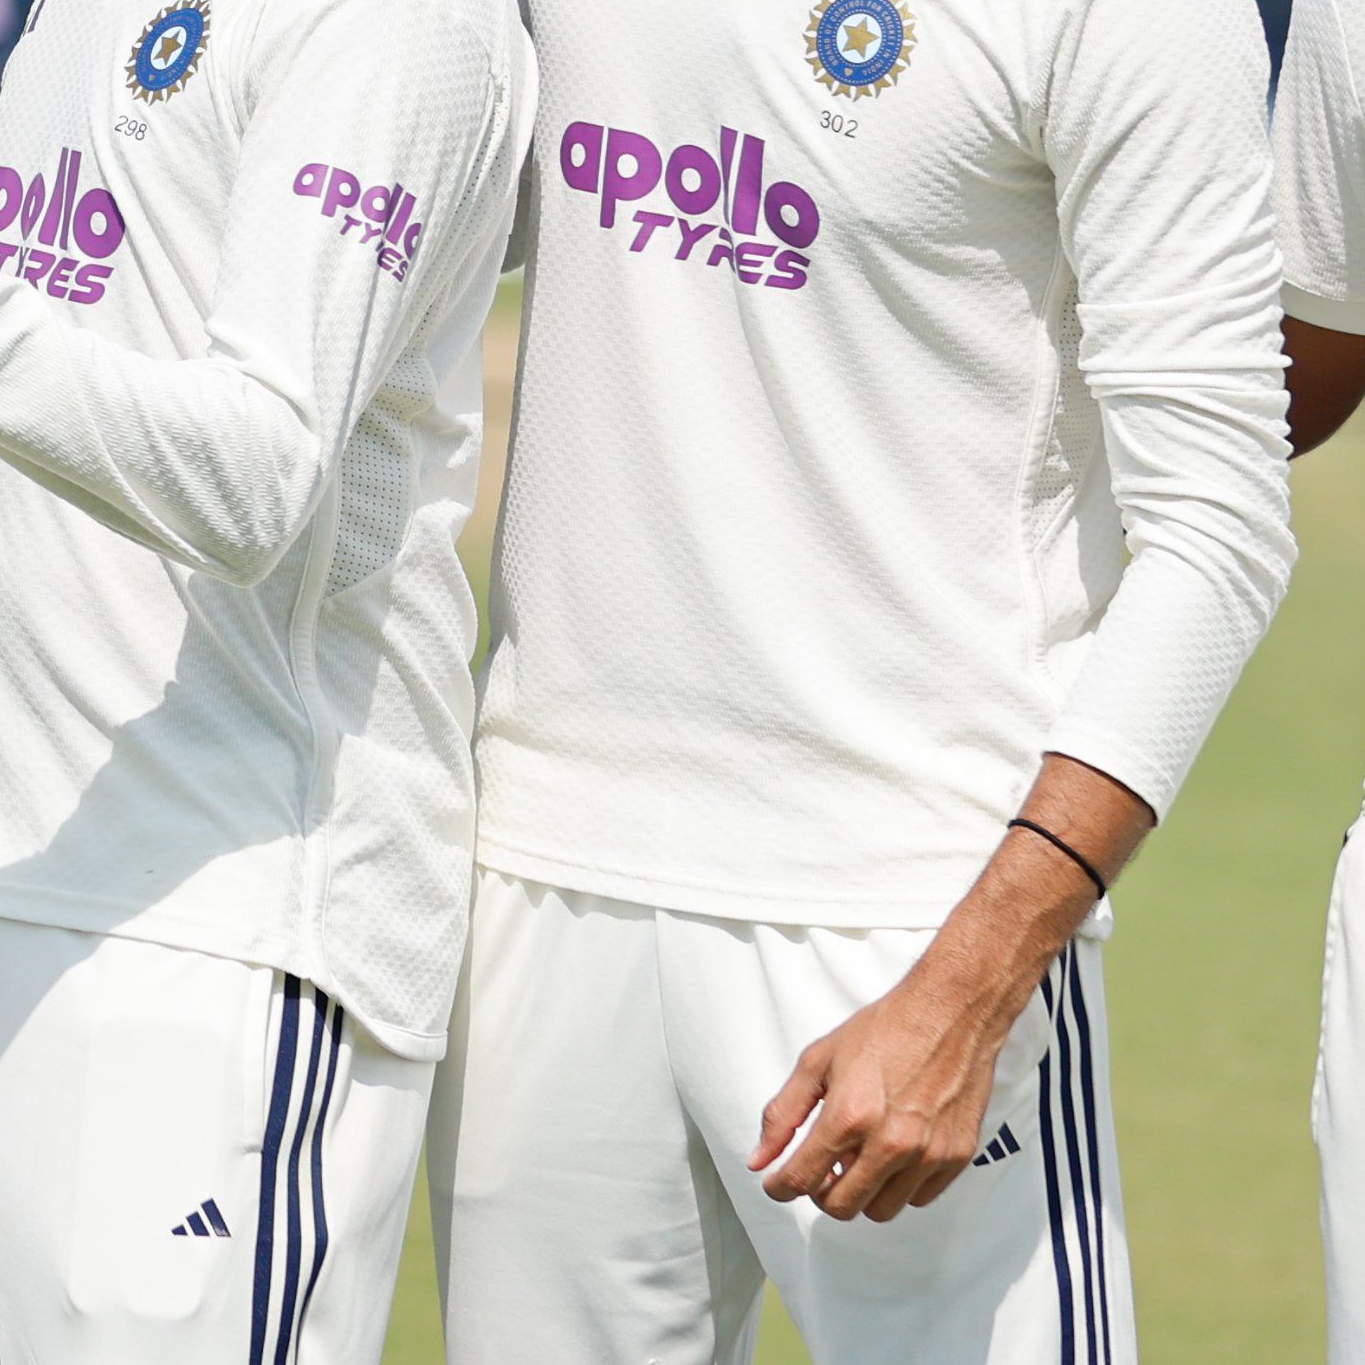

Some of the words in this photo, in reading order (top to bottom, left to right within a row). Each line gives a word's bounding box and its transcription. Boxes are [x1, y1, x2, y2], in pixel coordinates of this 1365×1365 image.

[114, 115, 148, 141] 298
[820, 110, 859, 139] 302
[560, 120, 820, 249] apollo
[629, 210, 811, 291] TYRES
